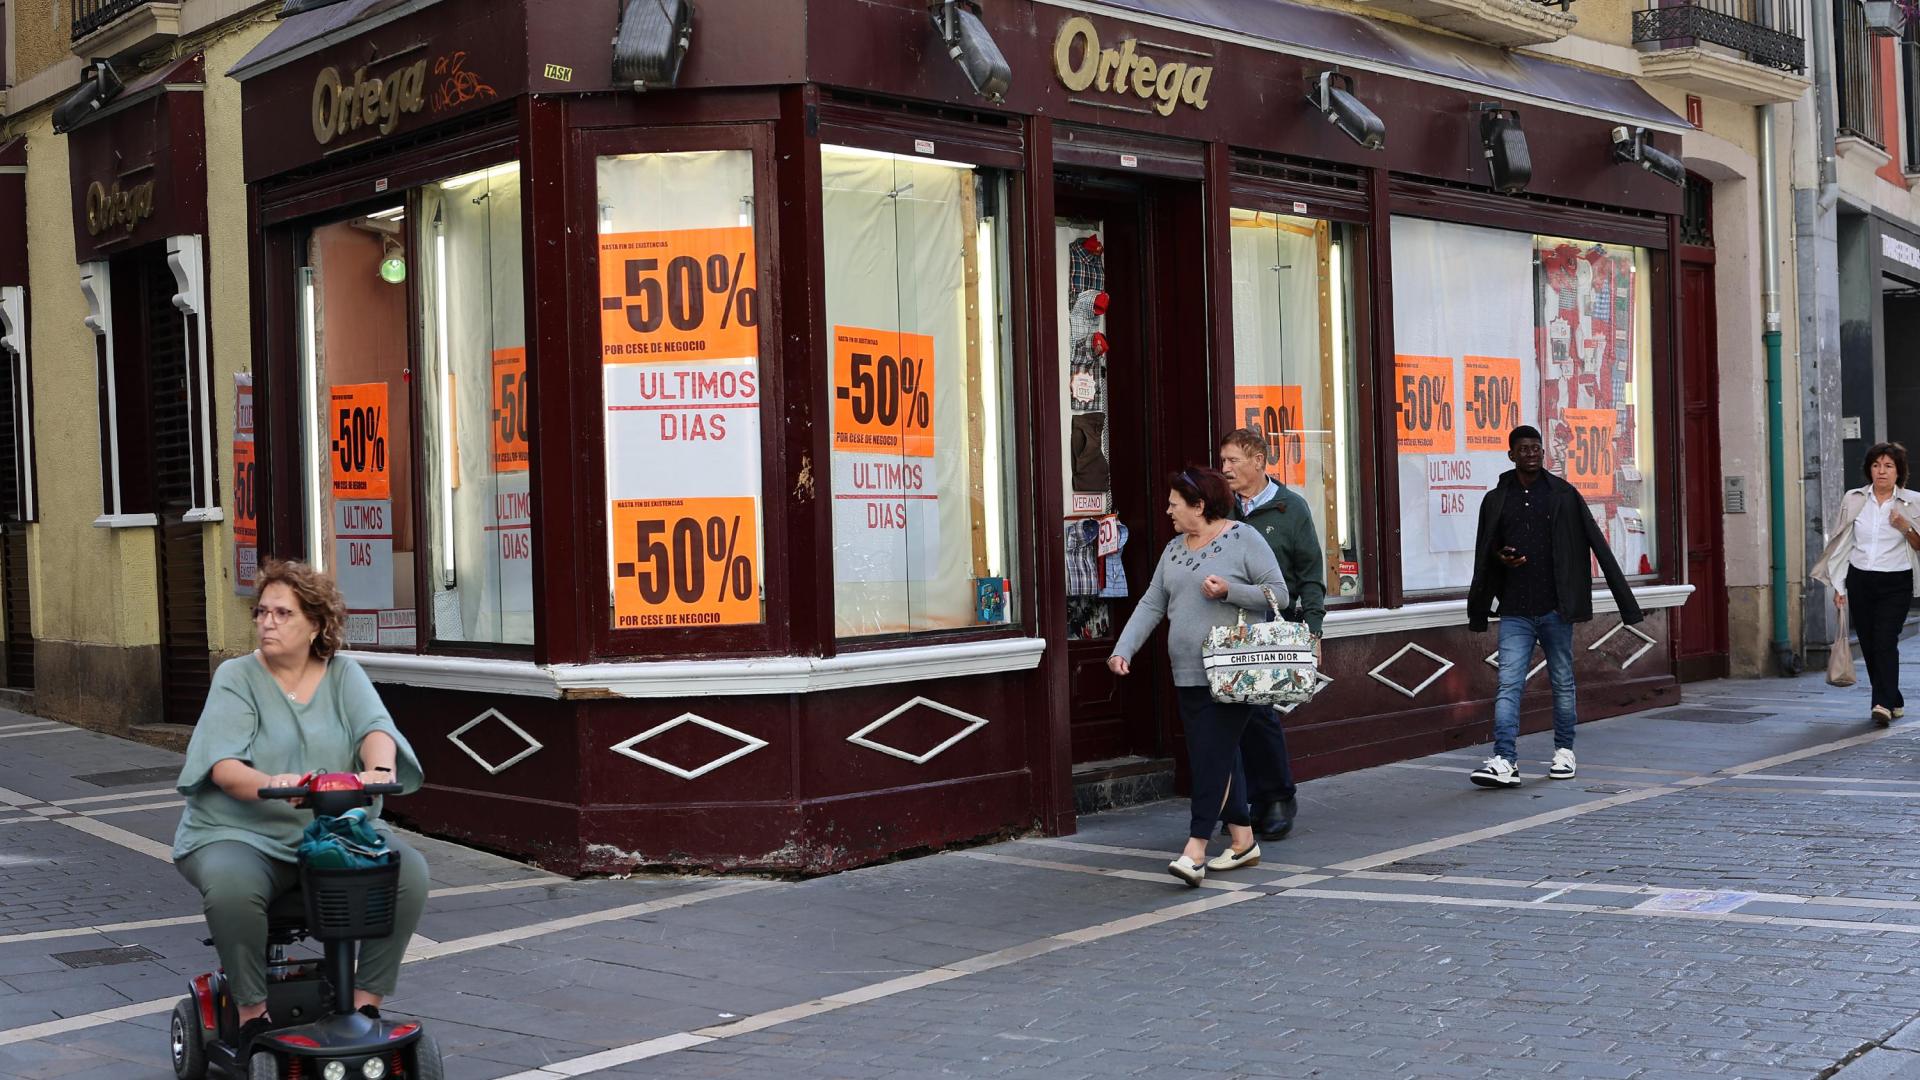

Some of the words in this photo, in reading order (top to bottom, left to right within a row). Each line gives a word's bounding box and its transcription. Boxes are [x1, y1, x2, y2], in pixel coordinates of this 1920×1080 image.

[546, 64, 571, 81] TASK
[1054, 16, 1213, 117] Ortega
[312, 59, 427, 145] Ortega
[86, 180, 155, 235] Ortega
[602, 252, 758, 333] -50%
[605, 344, 623, 355] POR
[625, 343, 648, 354] CESE
[651, 342, 662, 353] DE
[664, 340, 706, 353] NEGOCIO
[640, 371, 756, 400] ULTIMOS
[837, 352, 929, 428] -50%
[1394, 375, 1452, 432] -50%
[1465, 376, 1519, 430] -50%
[332, 406, 385, 473] -50%
[660, 413, 726, 441] DIAS
[1568, 425, 1611, 476] -50%
[853, 462, 922, 490] ULTIMOS
[496, 492, 531, 520] ULTIMO
[867, 502, 906, 529] DIAS
[1074, 496, 1101, 509] VERANO
[343, 505, 383, 530] ULTIMOS
[350, 542, 371, 566] DIAS
[503, 533, 529, 560] DIAS
[617, 515, 753, 605] -50%
[619, 615, 638, 626] POR
[641, 614, 663, 625] CESE
[666, 614, 677, 624] DE
[679, 612, 720, 624] NEGOCIO
[1230, 653, 1276, 663] CHRISTIAN
[1278, 653, 1298, 662] DIOR
